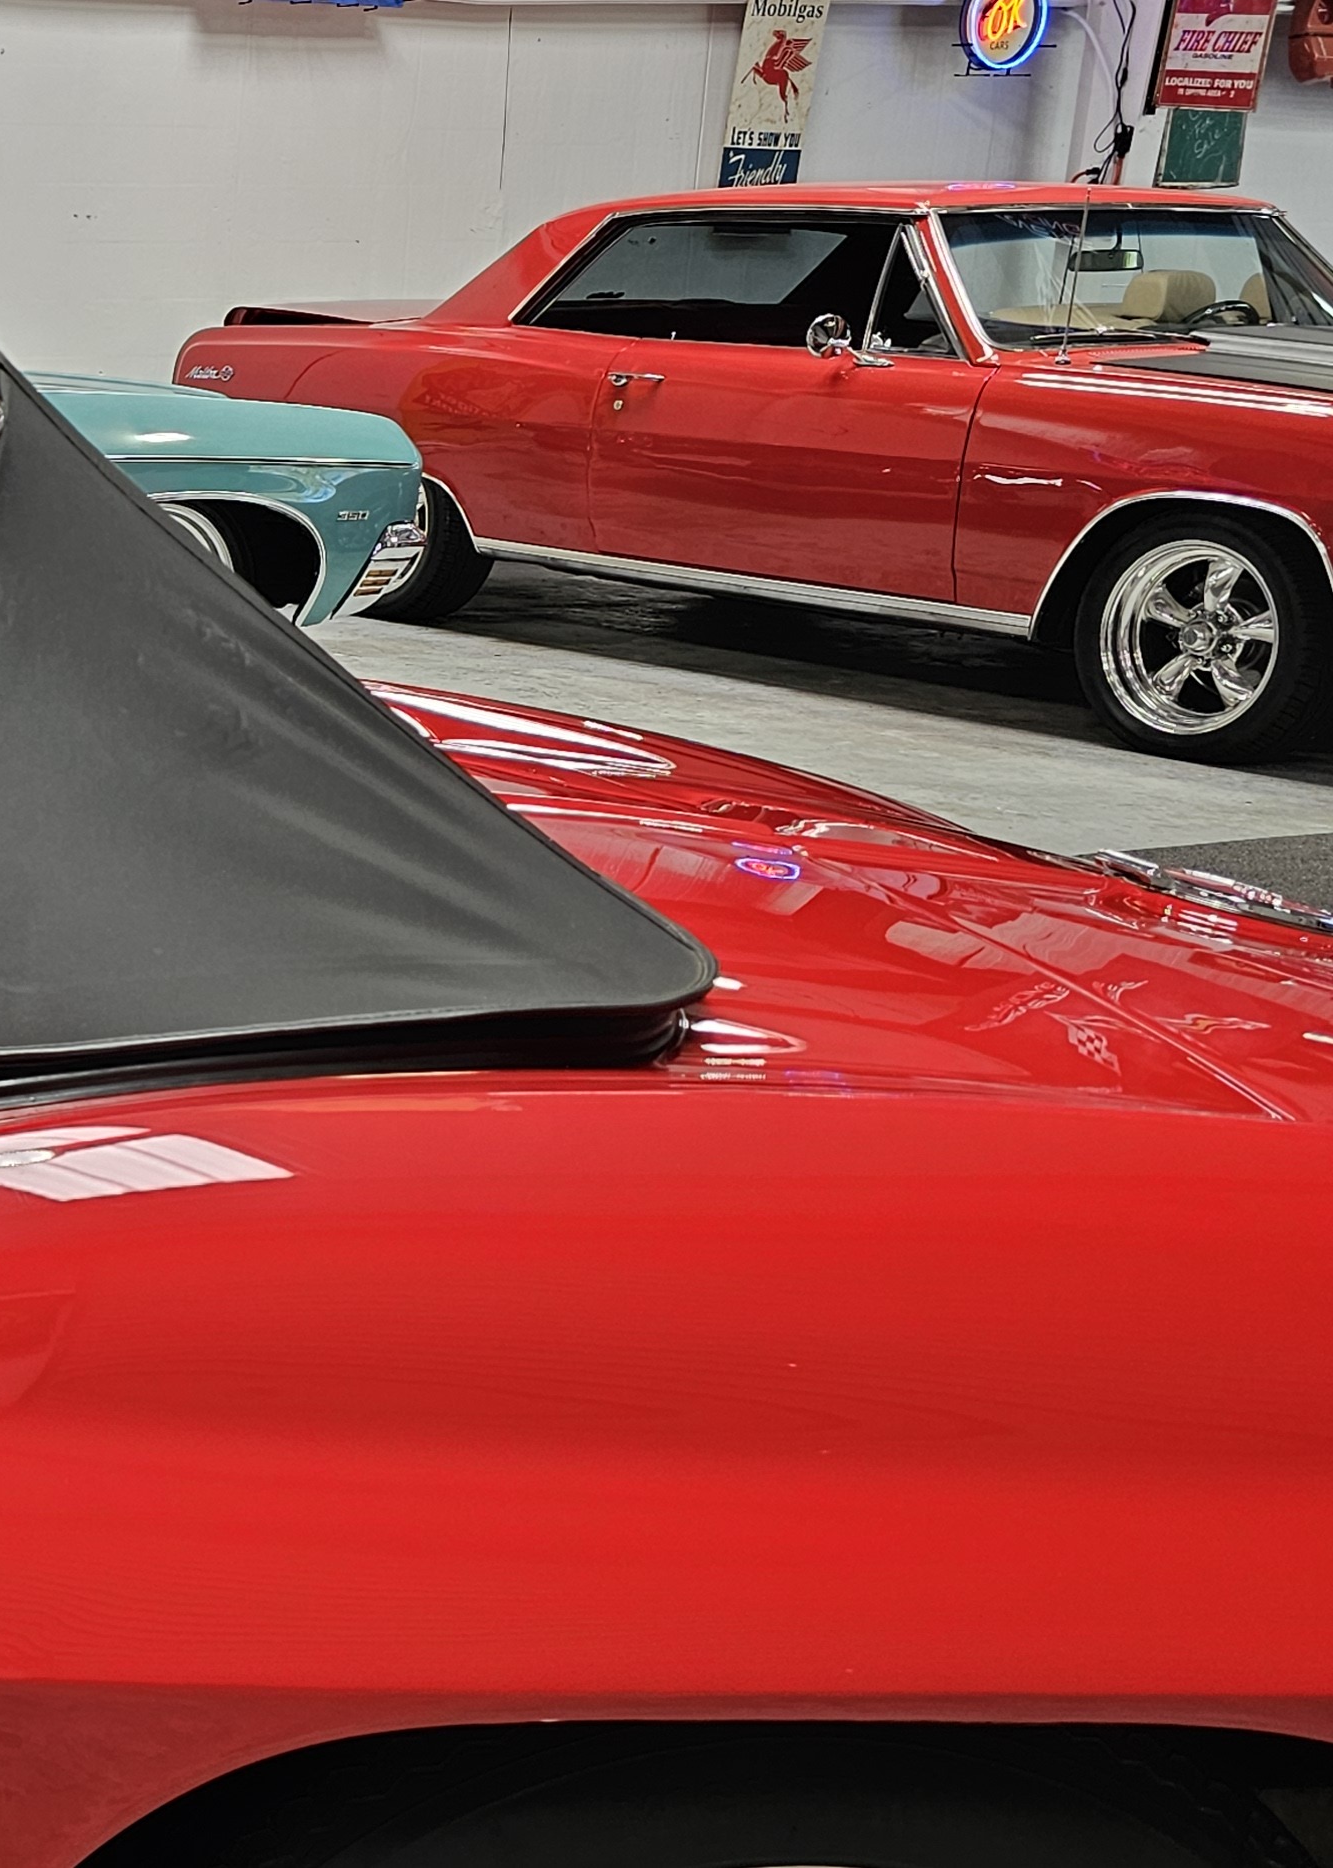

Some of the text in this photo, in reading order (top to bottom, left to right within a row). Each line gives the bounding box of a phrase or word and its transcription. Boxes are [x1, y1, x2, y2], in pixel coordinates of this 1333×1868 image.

[751, 0, 824, 23] Mobilgas
[982, 0, 1027, 40] OK
[1173, 30, 1263, 53] FIRE CHIEF
[1192, 52, 1234, 60] GASOLINE
[1165, 77, 1254, 90] LOCALIZED FOR YOU
[730, 126, 802, 148] LET'S SHOW YOU
[727, 150, 787, 188] Friendly
[336, 510, 370, 521] 350
